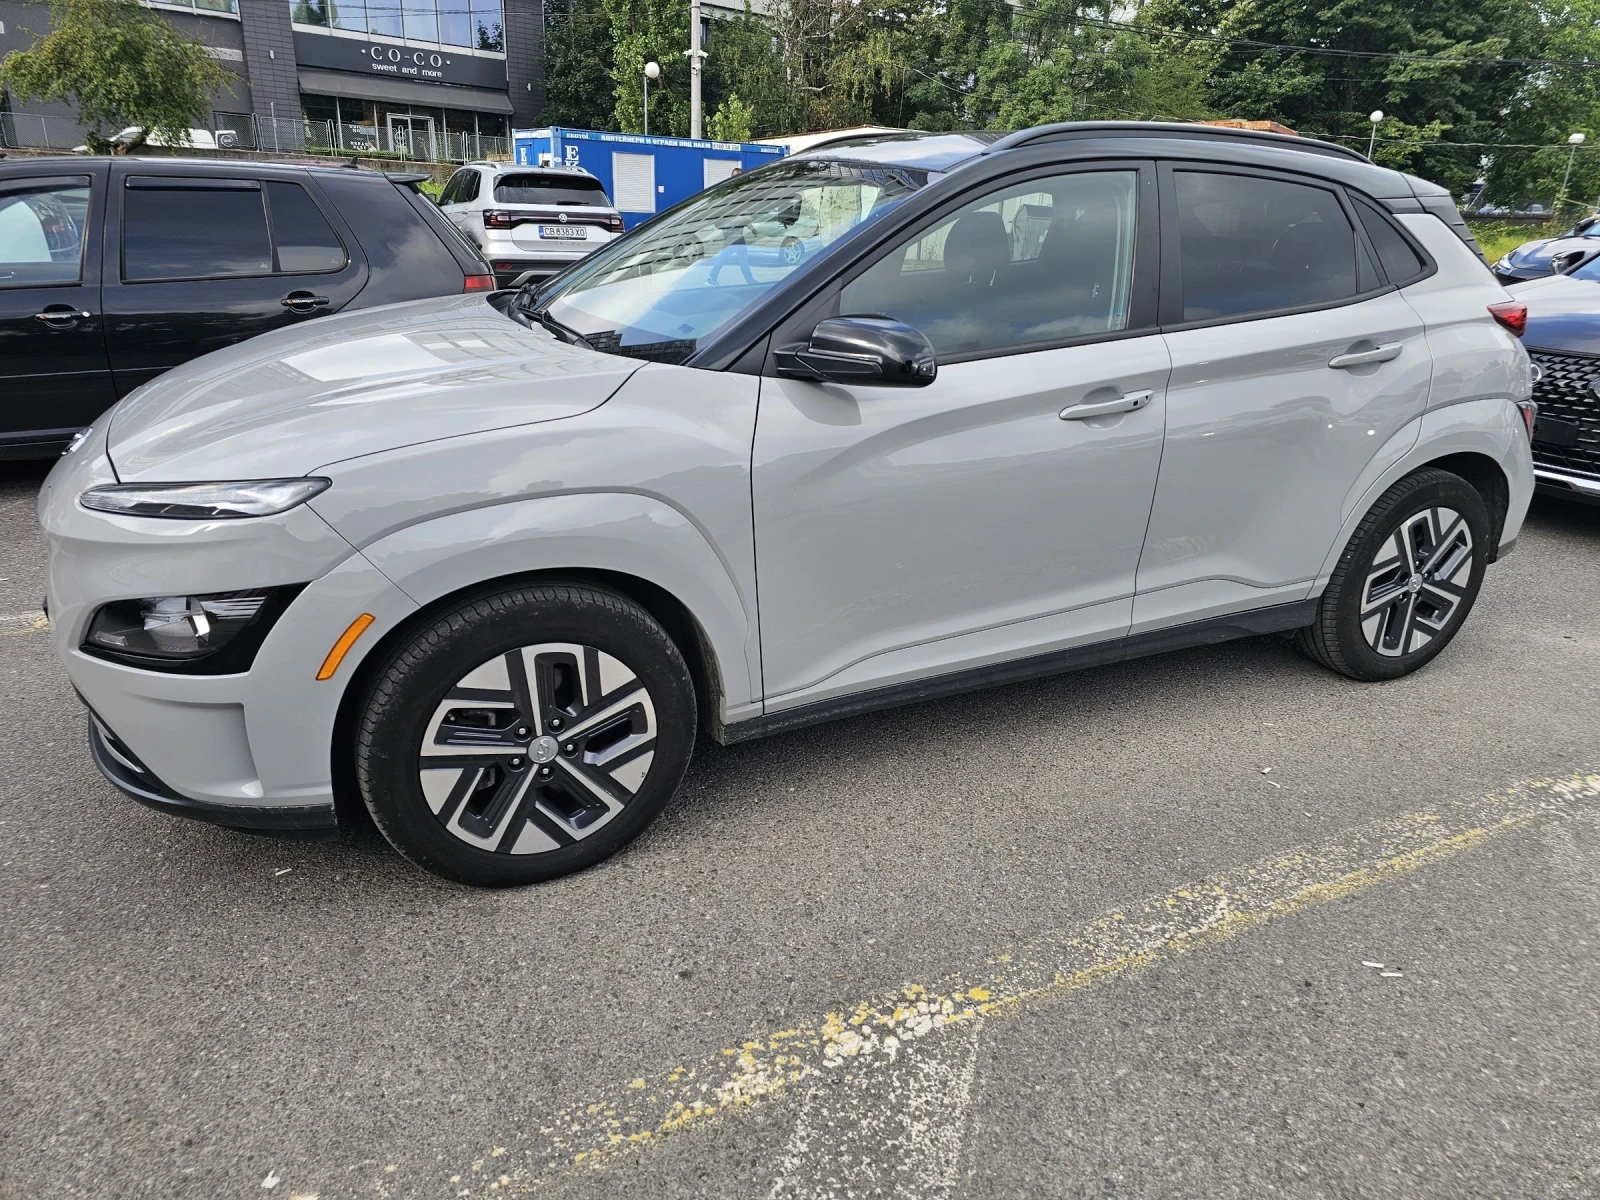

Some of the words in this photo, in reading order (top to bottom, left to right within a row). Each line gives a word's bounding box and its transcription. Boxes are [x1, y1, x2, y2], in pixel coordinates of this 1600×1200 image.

[371, 63, 397, 72] sweet
[401, 66, 418, 75] and
[422, 69, 442, 77] more
[601, 134, 645, 144] КОНТЕЙНЕРИ
[652, 138, 678, 147] ОГРАДИ
[679, 140, 692, 148] ПОД
[693, 141, 711, 149] НАЕМ
[545, 227, 555, 235] CB
[556, 228, 574, 236] 8383
